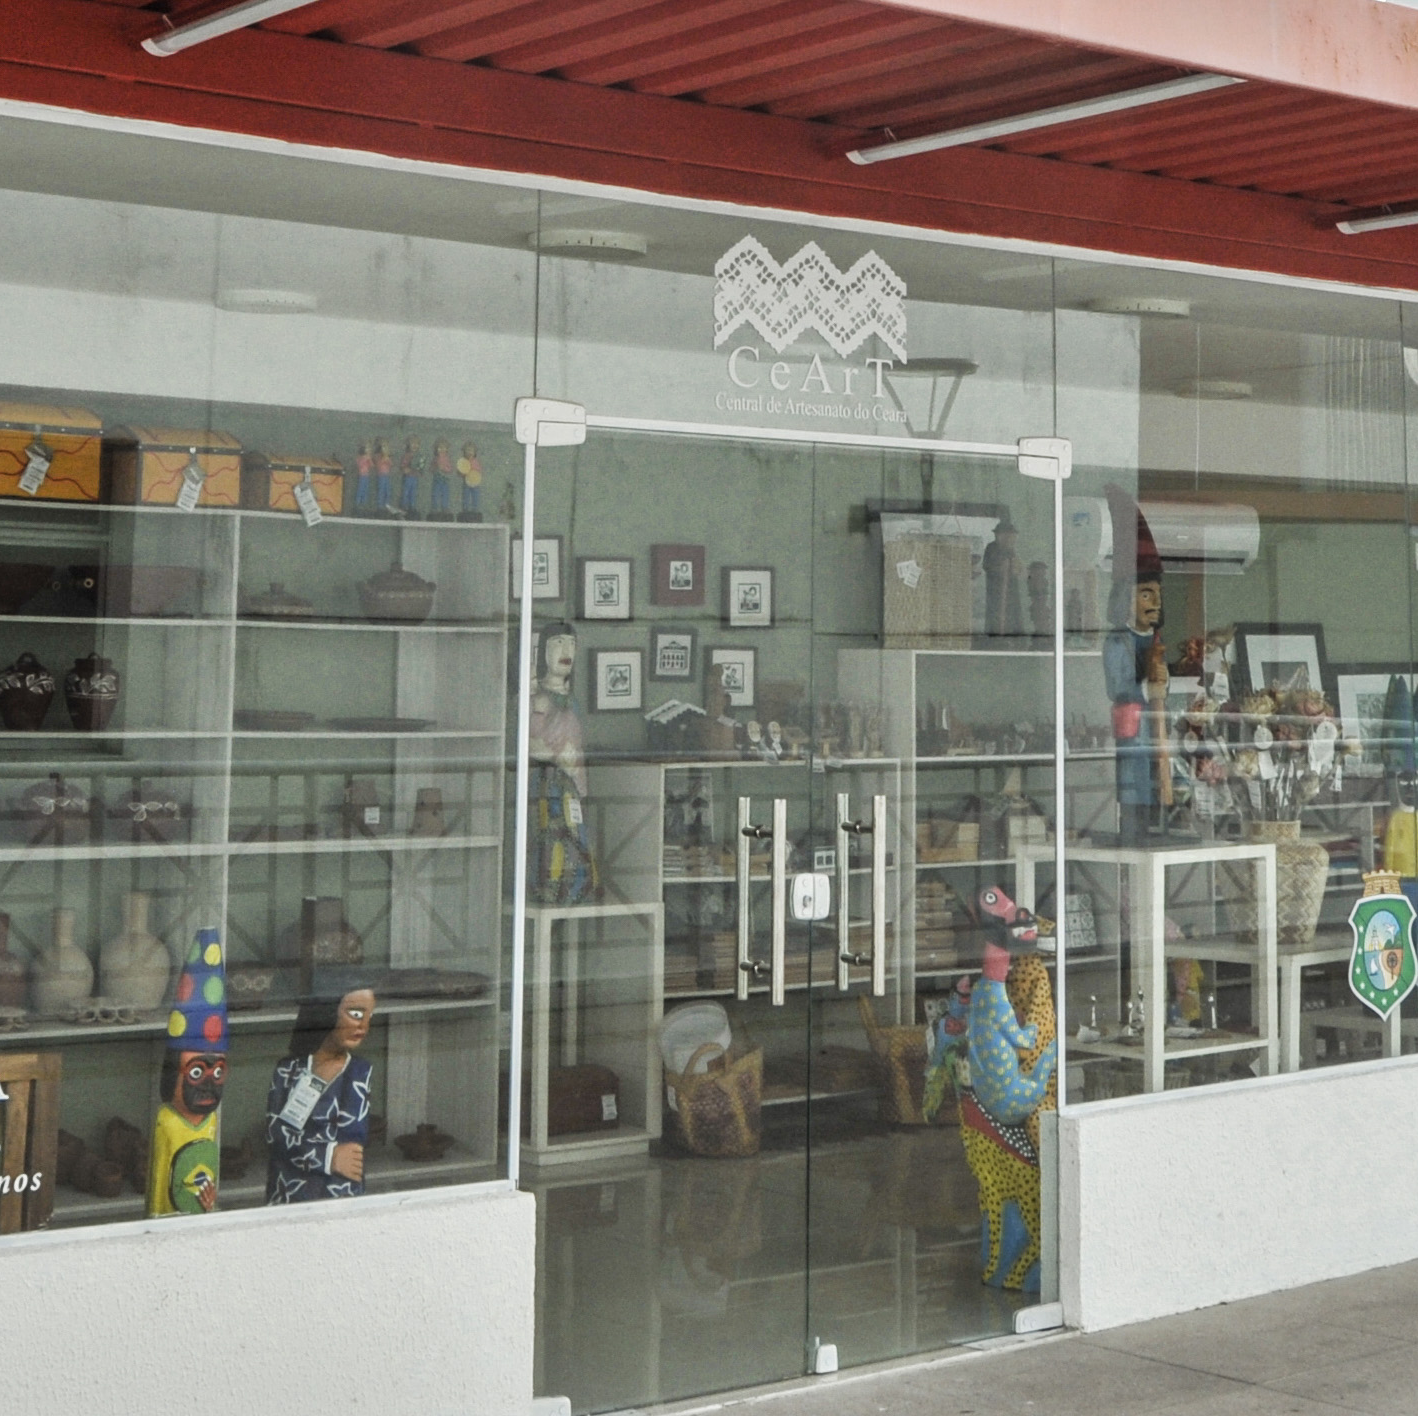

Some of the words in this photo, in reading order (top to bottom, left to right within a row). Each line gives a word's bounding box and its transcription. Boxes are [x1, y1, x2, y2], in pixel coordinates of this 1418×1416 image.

[728, 346, 893, 398] CeArT
[716, 392, 762, 411] Central
[767, 396, 781, 414] de
[785, 397, 850, 418] Artesanato
[854, 403, 868, 420] do
